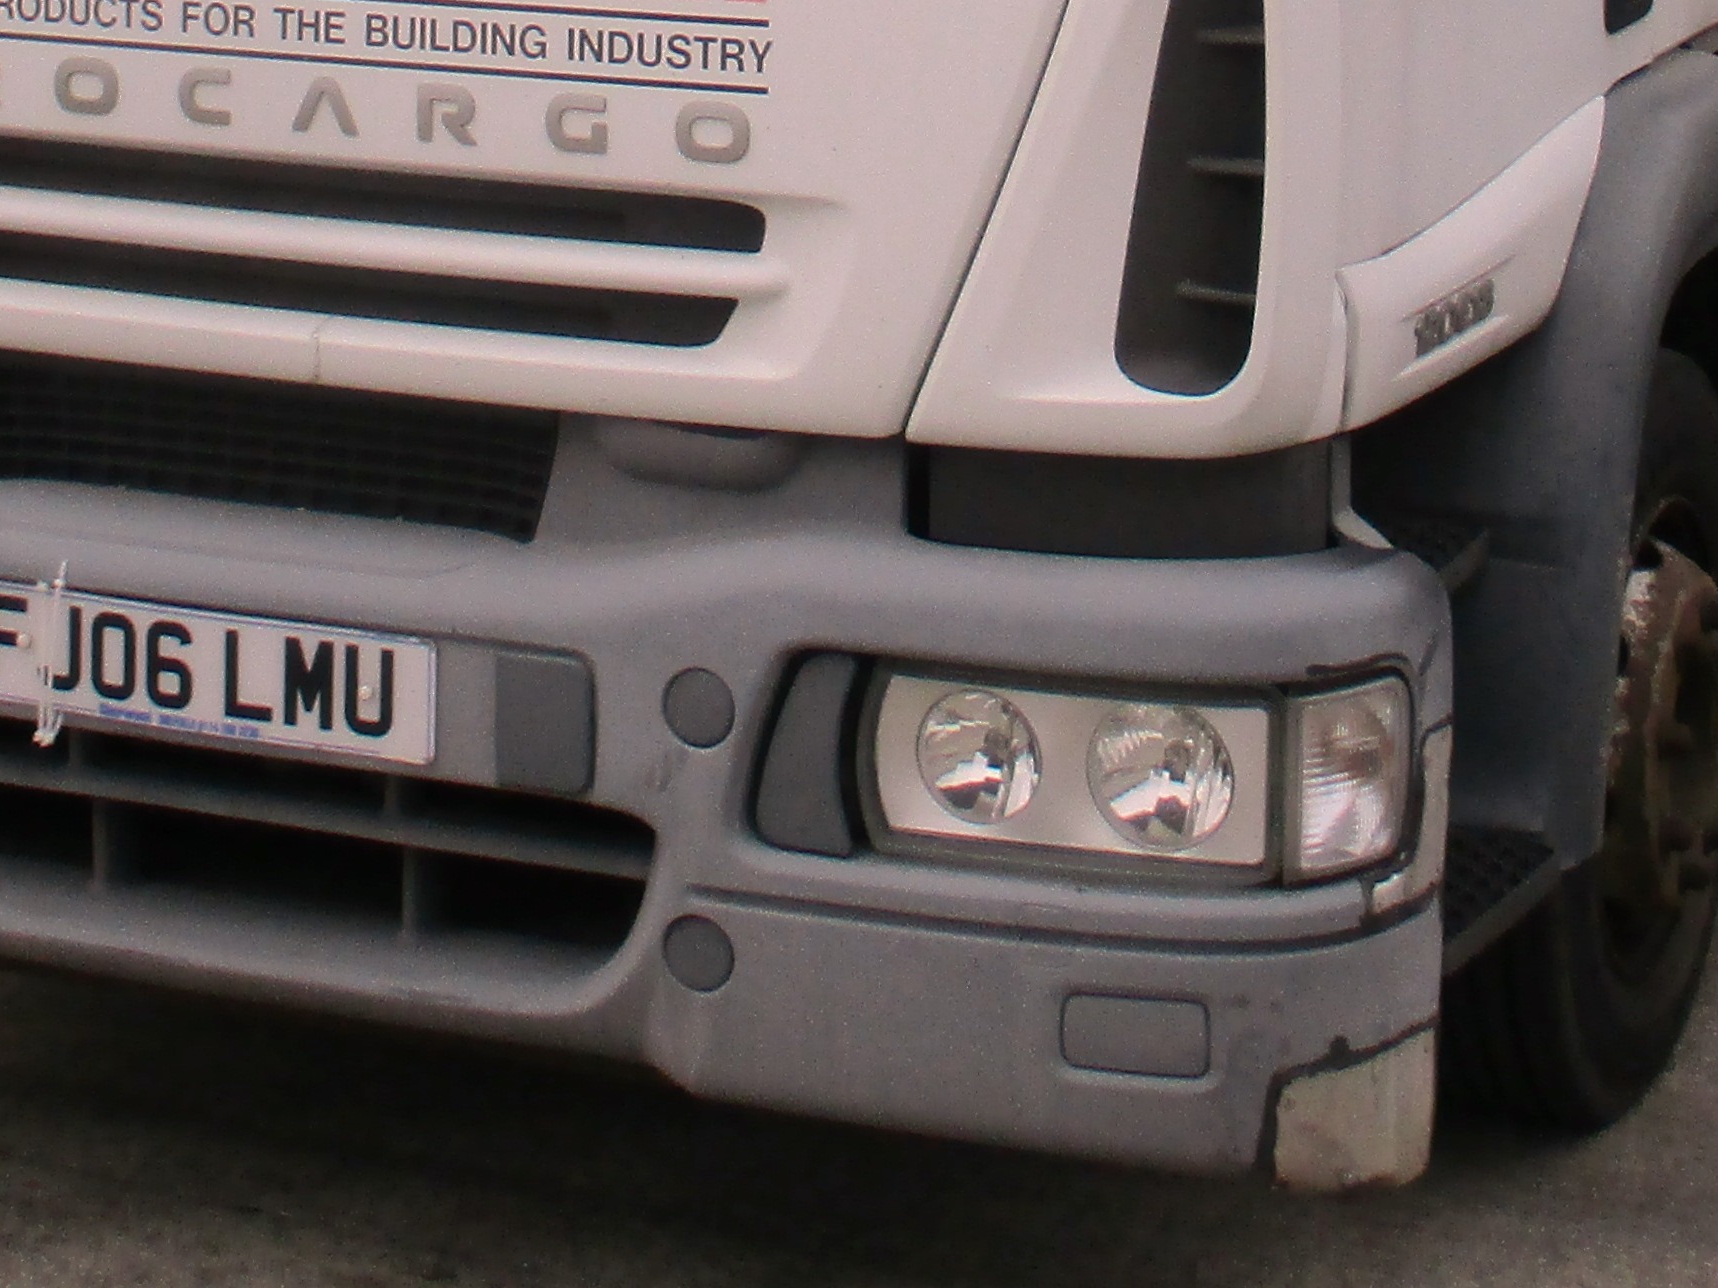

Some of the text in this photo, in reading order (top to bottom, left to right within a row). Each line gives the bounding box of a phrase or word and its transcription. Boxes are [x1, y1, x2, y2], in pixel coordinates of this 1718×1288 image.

[181, 1, 257, 39] FOR
[273, 6, 347, 45] THE
[365, 12, 548, 60] BUILDING
[567, 26, 774, 73] INDUSTRY
[223, 627, 395, 738] LMU
